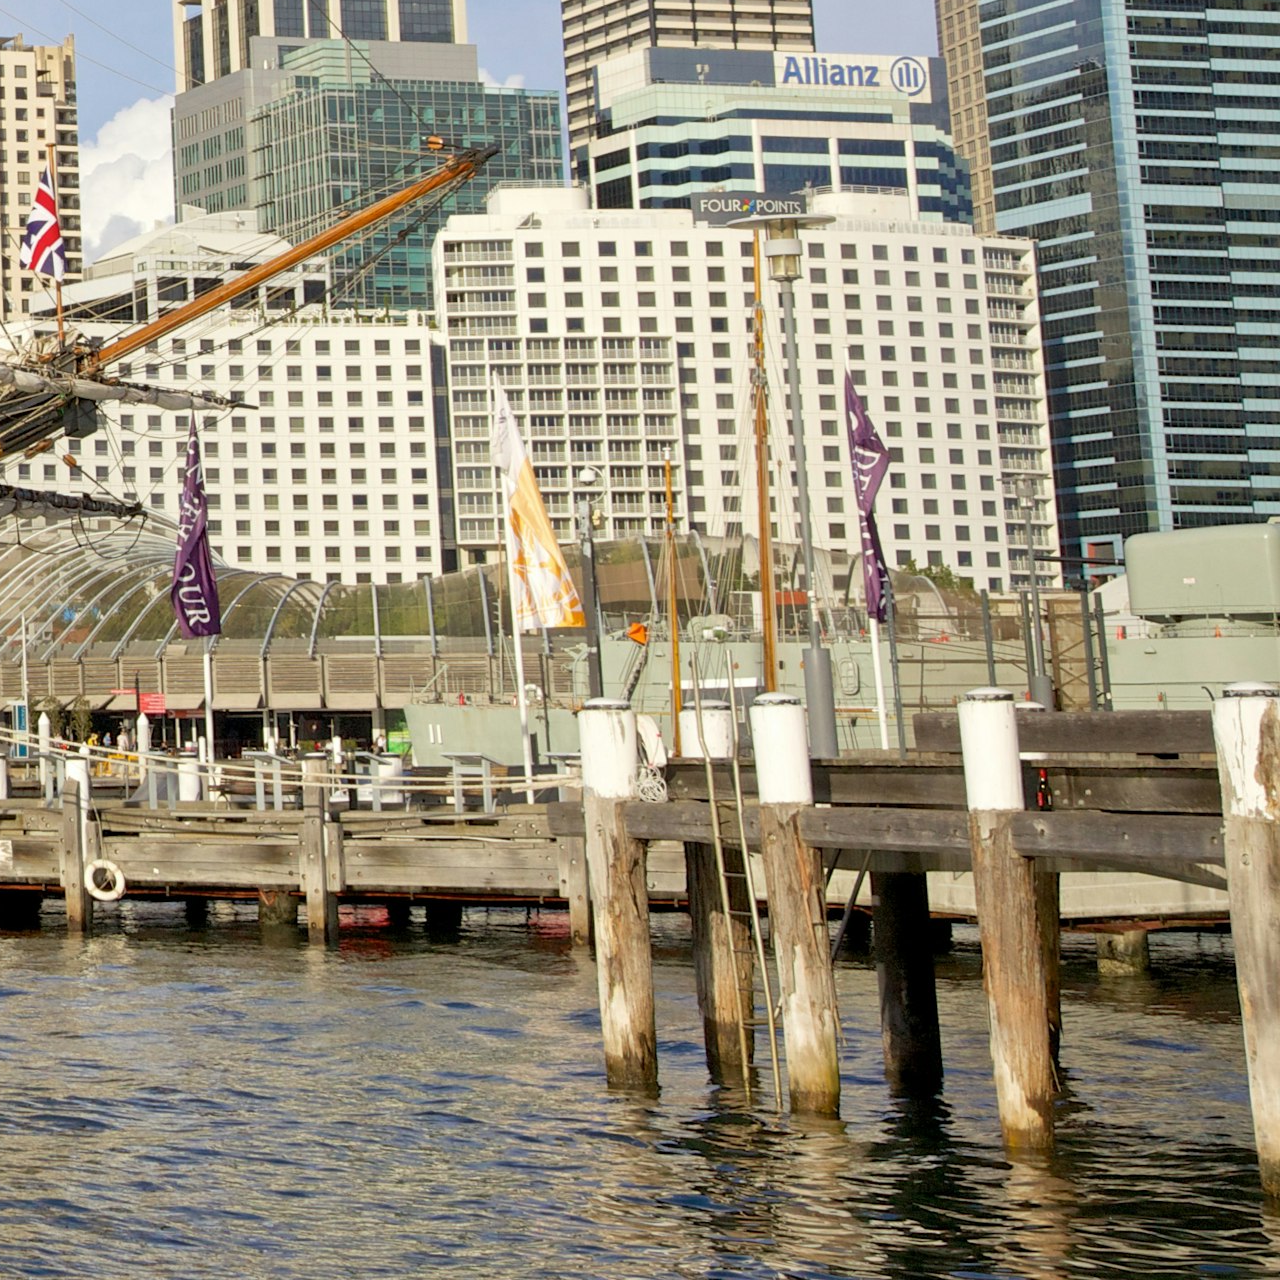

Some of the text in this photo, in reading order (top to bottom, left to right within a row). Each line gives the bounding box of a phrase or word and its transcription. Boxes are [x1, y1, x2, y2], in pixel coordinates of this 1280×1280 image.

[782, 56, 880, 87] Allianz
[700, 199, 801, 214] FOUR POINTS
[428, 723, 442, 744] 11
